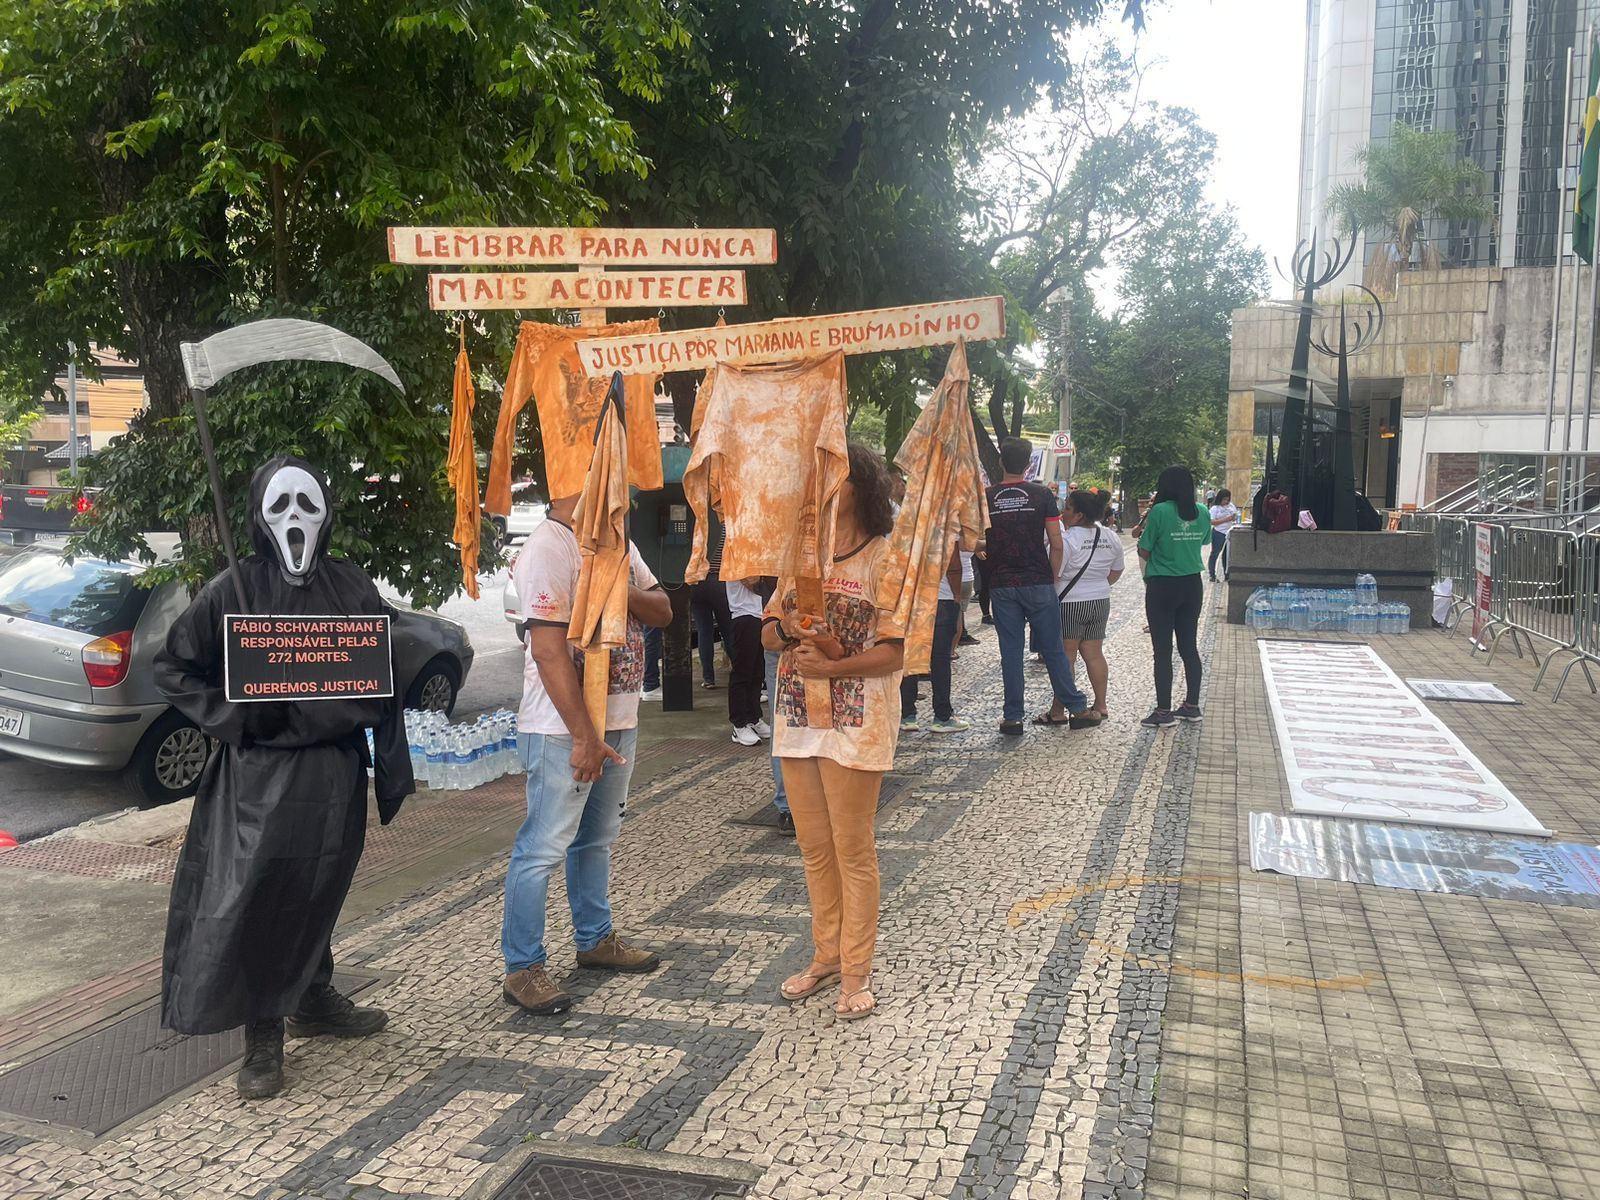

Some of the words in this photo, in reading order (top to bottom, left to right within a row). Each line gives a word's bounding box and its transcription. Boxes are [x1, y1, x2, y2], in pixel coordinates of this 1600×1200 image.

[415, 233, 565, 258] LEMBRAR
[580, 237, 648, 259] PARA
[661, 237, 756, 259] NUNCA
[438, 276, 527, 302] MAIS
[550, 275, 736, 300] ACONTECER
[591, 342, 681, 370] JUSTIÇA
[685, 339, 718, 361] POR
[725, 331, 805, 356] MARIANA
[810, 329, 821, 347] E
[1059, 436, 1065, 446] E
[232, 619, 272, 633] FÁBIO
[275, 621, 373, 633] SCHVARTSMAN
[375, 619, 384, 632] É
[240, 635, 335, 648] RESPONSÁVEL
[338, 636, 378, 648] PELAS
[268, 652, 293, 664] 272
[295, 651, 353, 664] MORTES.
[243, 681, 318, 695] QUEREMOS
[320, 679, 378, 694] JUSTIÇA!
